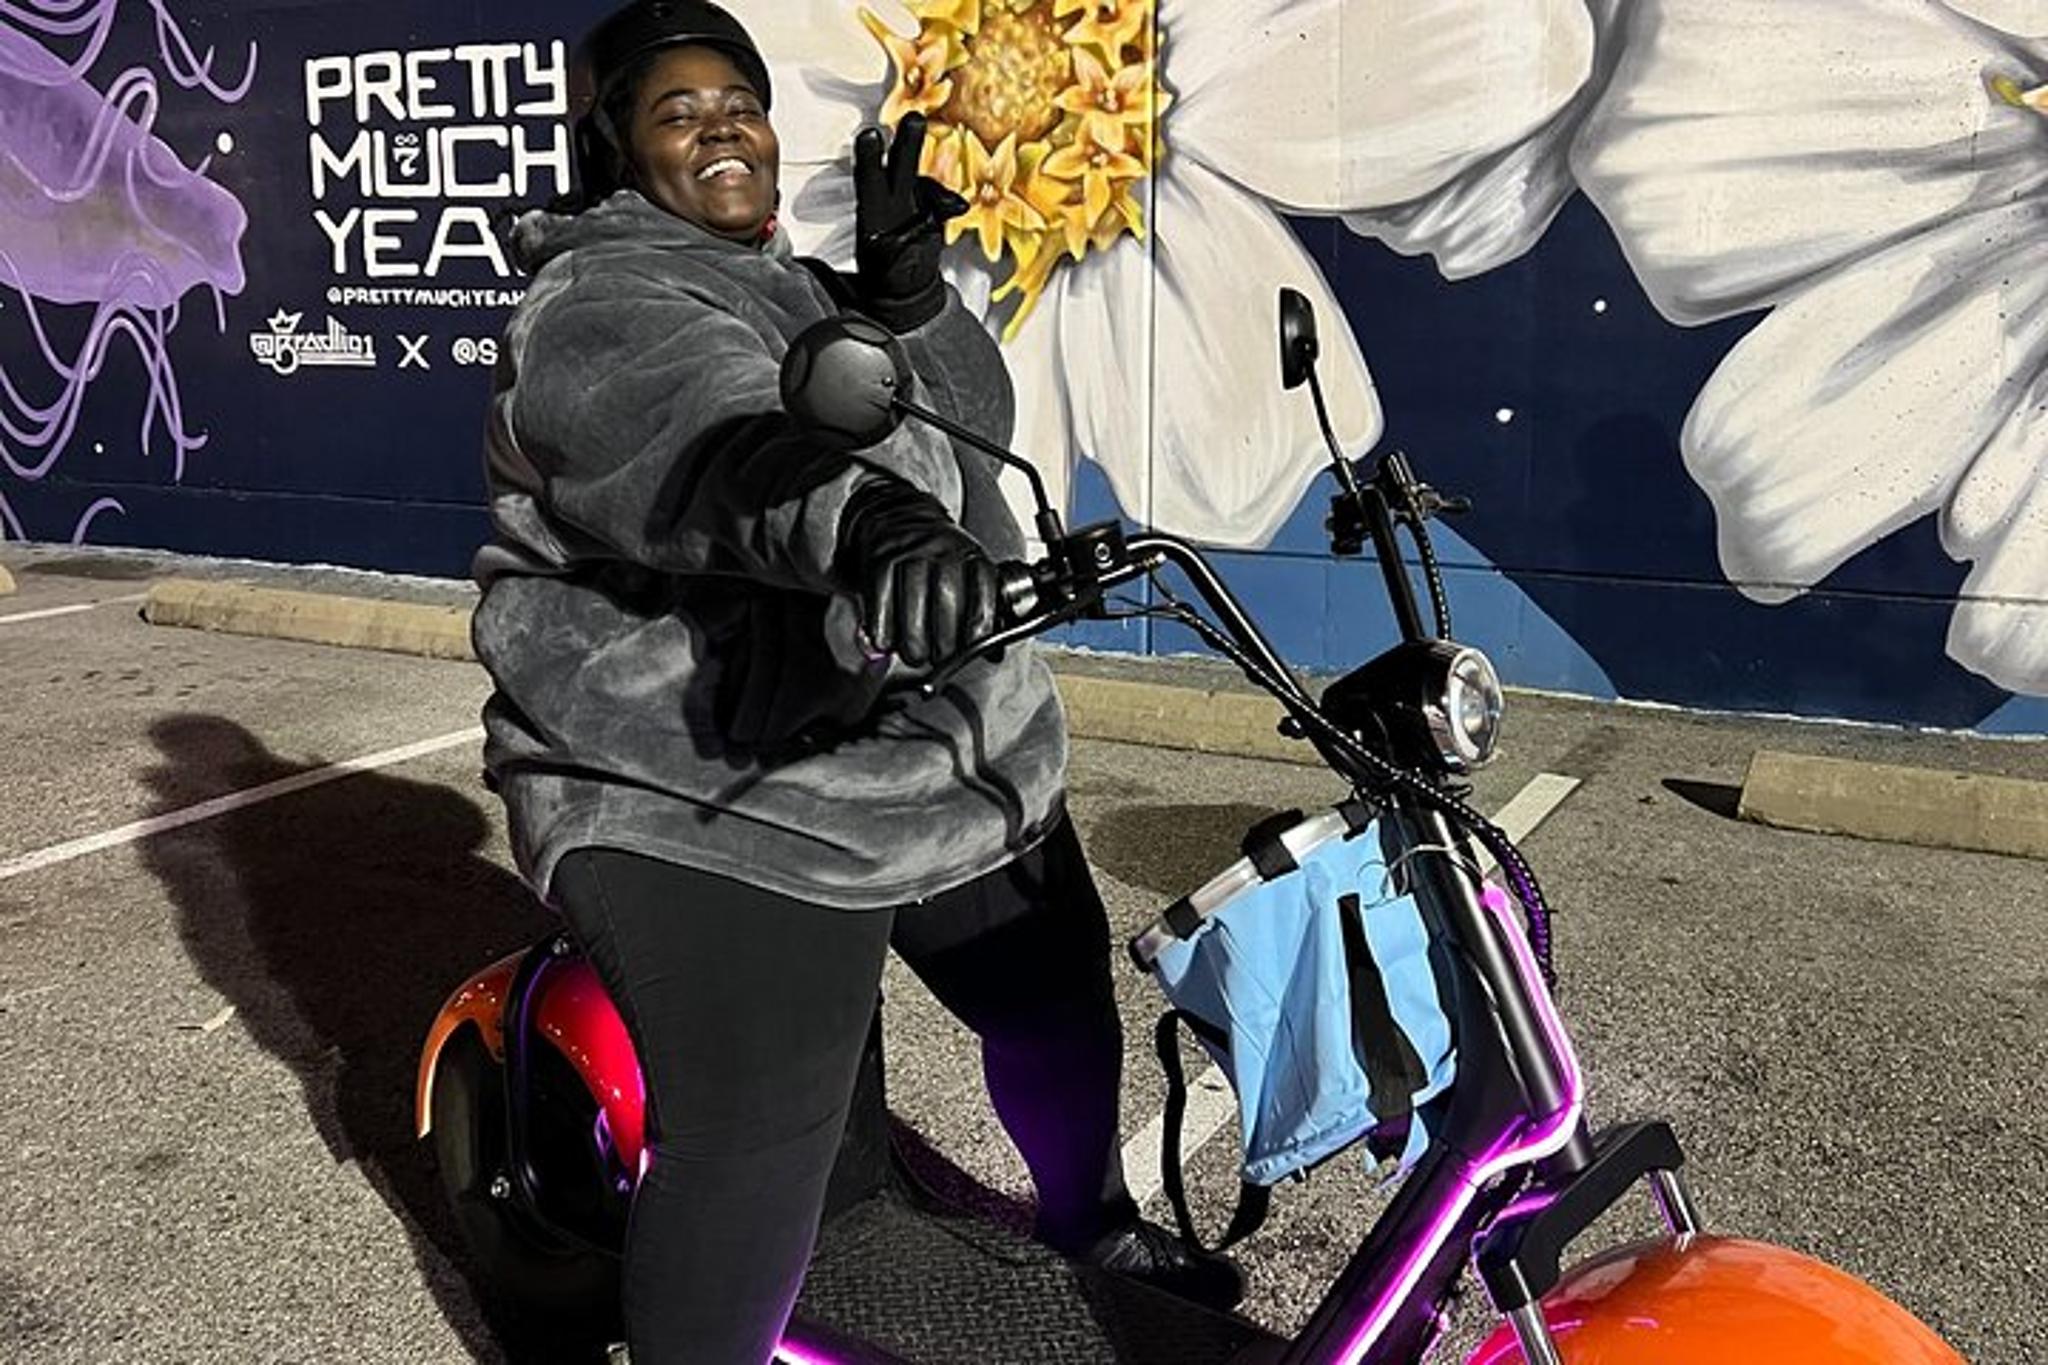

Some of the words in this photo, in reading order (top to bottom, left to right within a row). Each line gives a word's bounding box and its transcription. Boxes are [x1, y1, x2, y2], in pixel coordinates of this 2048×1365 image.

[306, 40, 567, 126] PRETTY
[310, 123, 570, 199] MUCH
[313, 207, 527, 277] YEA
